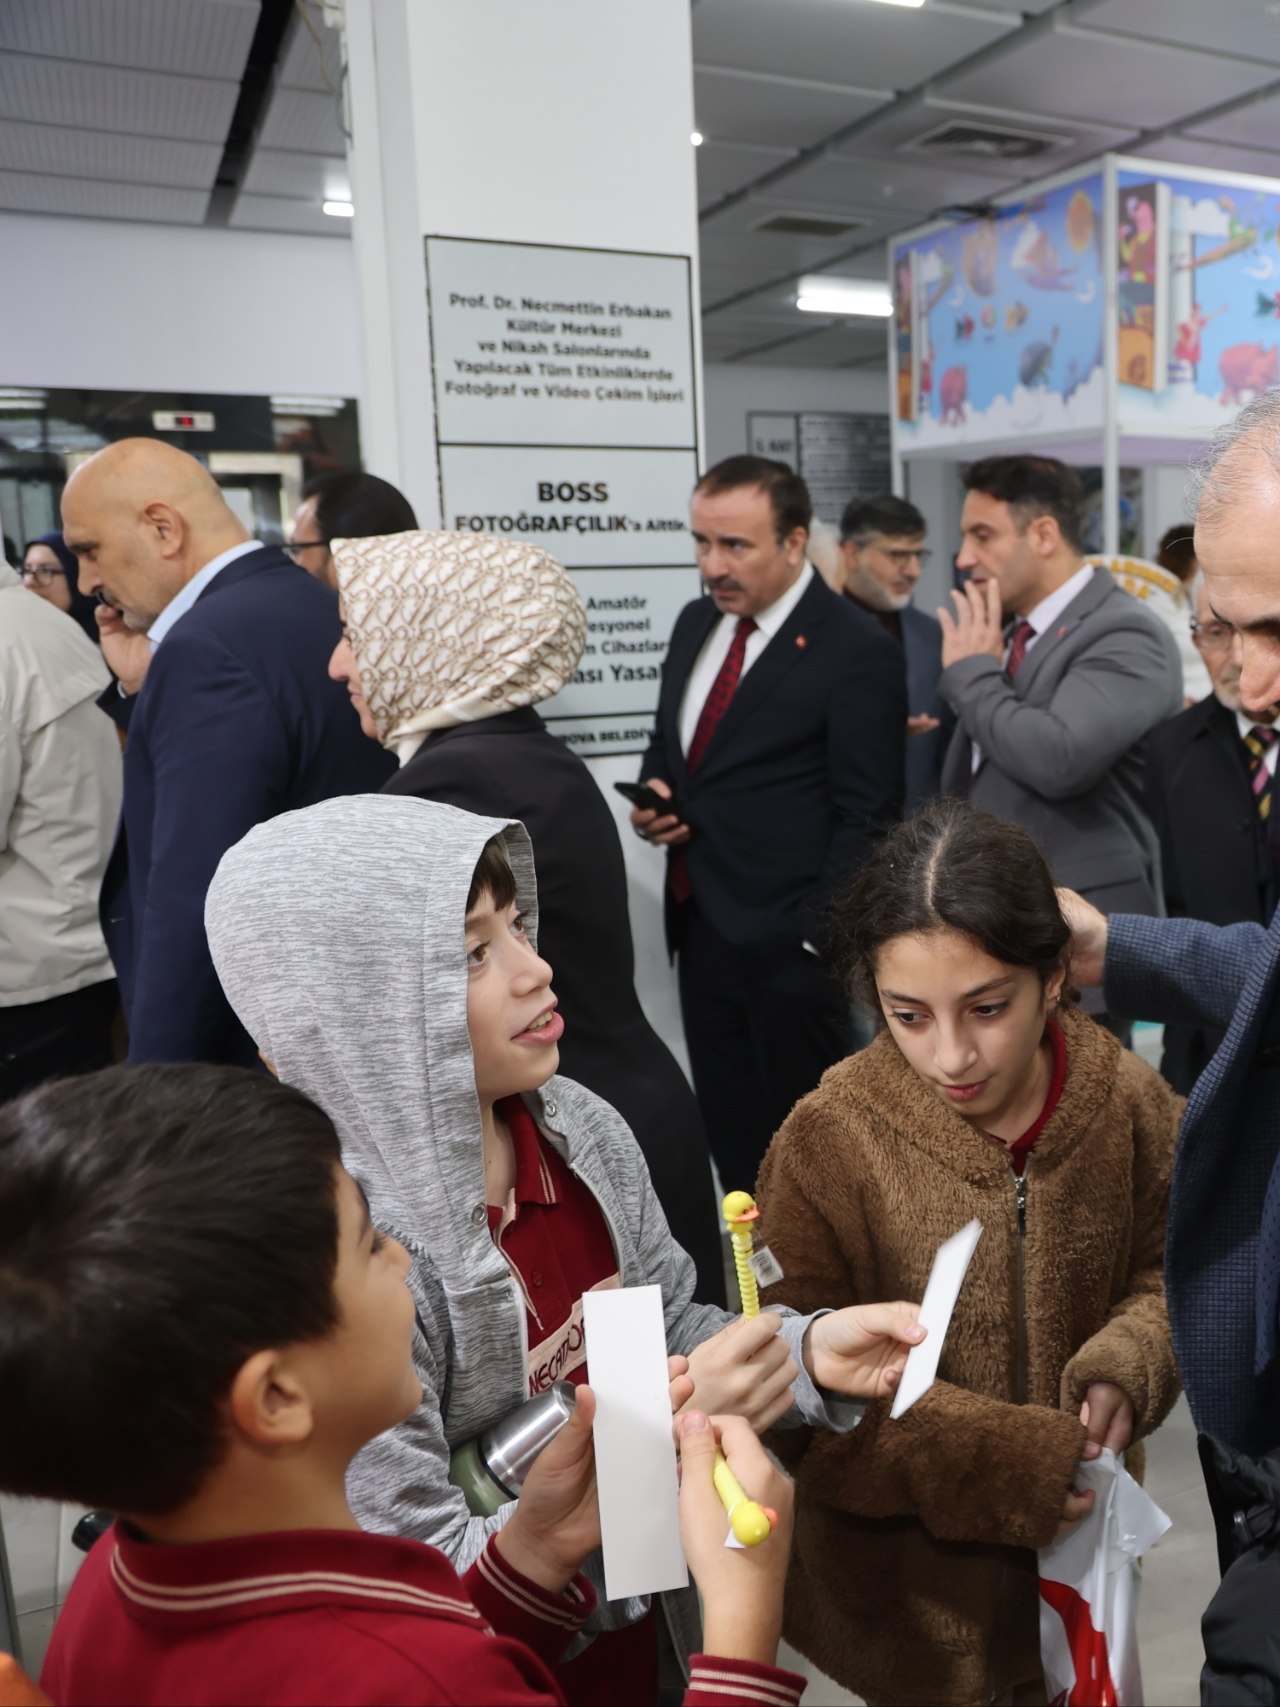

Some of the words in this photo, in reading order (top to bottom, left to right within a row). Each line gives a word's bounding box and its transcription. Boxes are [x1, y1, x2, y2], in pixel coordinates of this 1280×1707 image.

[450, 293, 488, 309] Prof.
[494, 296, 516, 310] Dr.
[521, 298, 604, 316] Necmettin
[609, 304, 672, 320] Erbakan
[507, 318, 556, 334] Kültür
[562, 321, 622, 337] Merkezi
[478, 341, 496, 351] ve
[502, 340, 547, 355] Nikah
[553, 342, 651, 360] Salonlarında
[454, 359, 532, 375] Yapılacak
[538, 362, 571, 377] Tüm
[577, 364, 673, 381] Etkinliklerde
[445, 380, 517, 397] Fotoğraf
[522, 387, 539, 397] ve
[545, 384, 589, 398] Video
[596, 386, 642, 403] Çekim
[648, 386, 684, 403] İşleri
[537, 482, 609, 503] BOSS
[587, 596, 647, 610] Amatör
[601, 640, 669, 655] Cihazlar
[610, 663, 662, 681] Yasa
